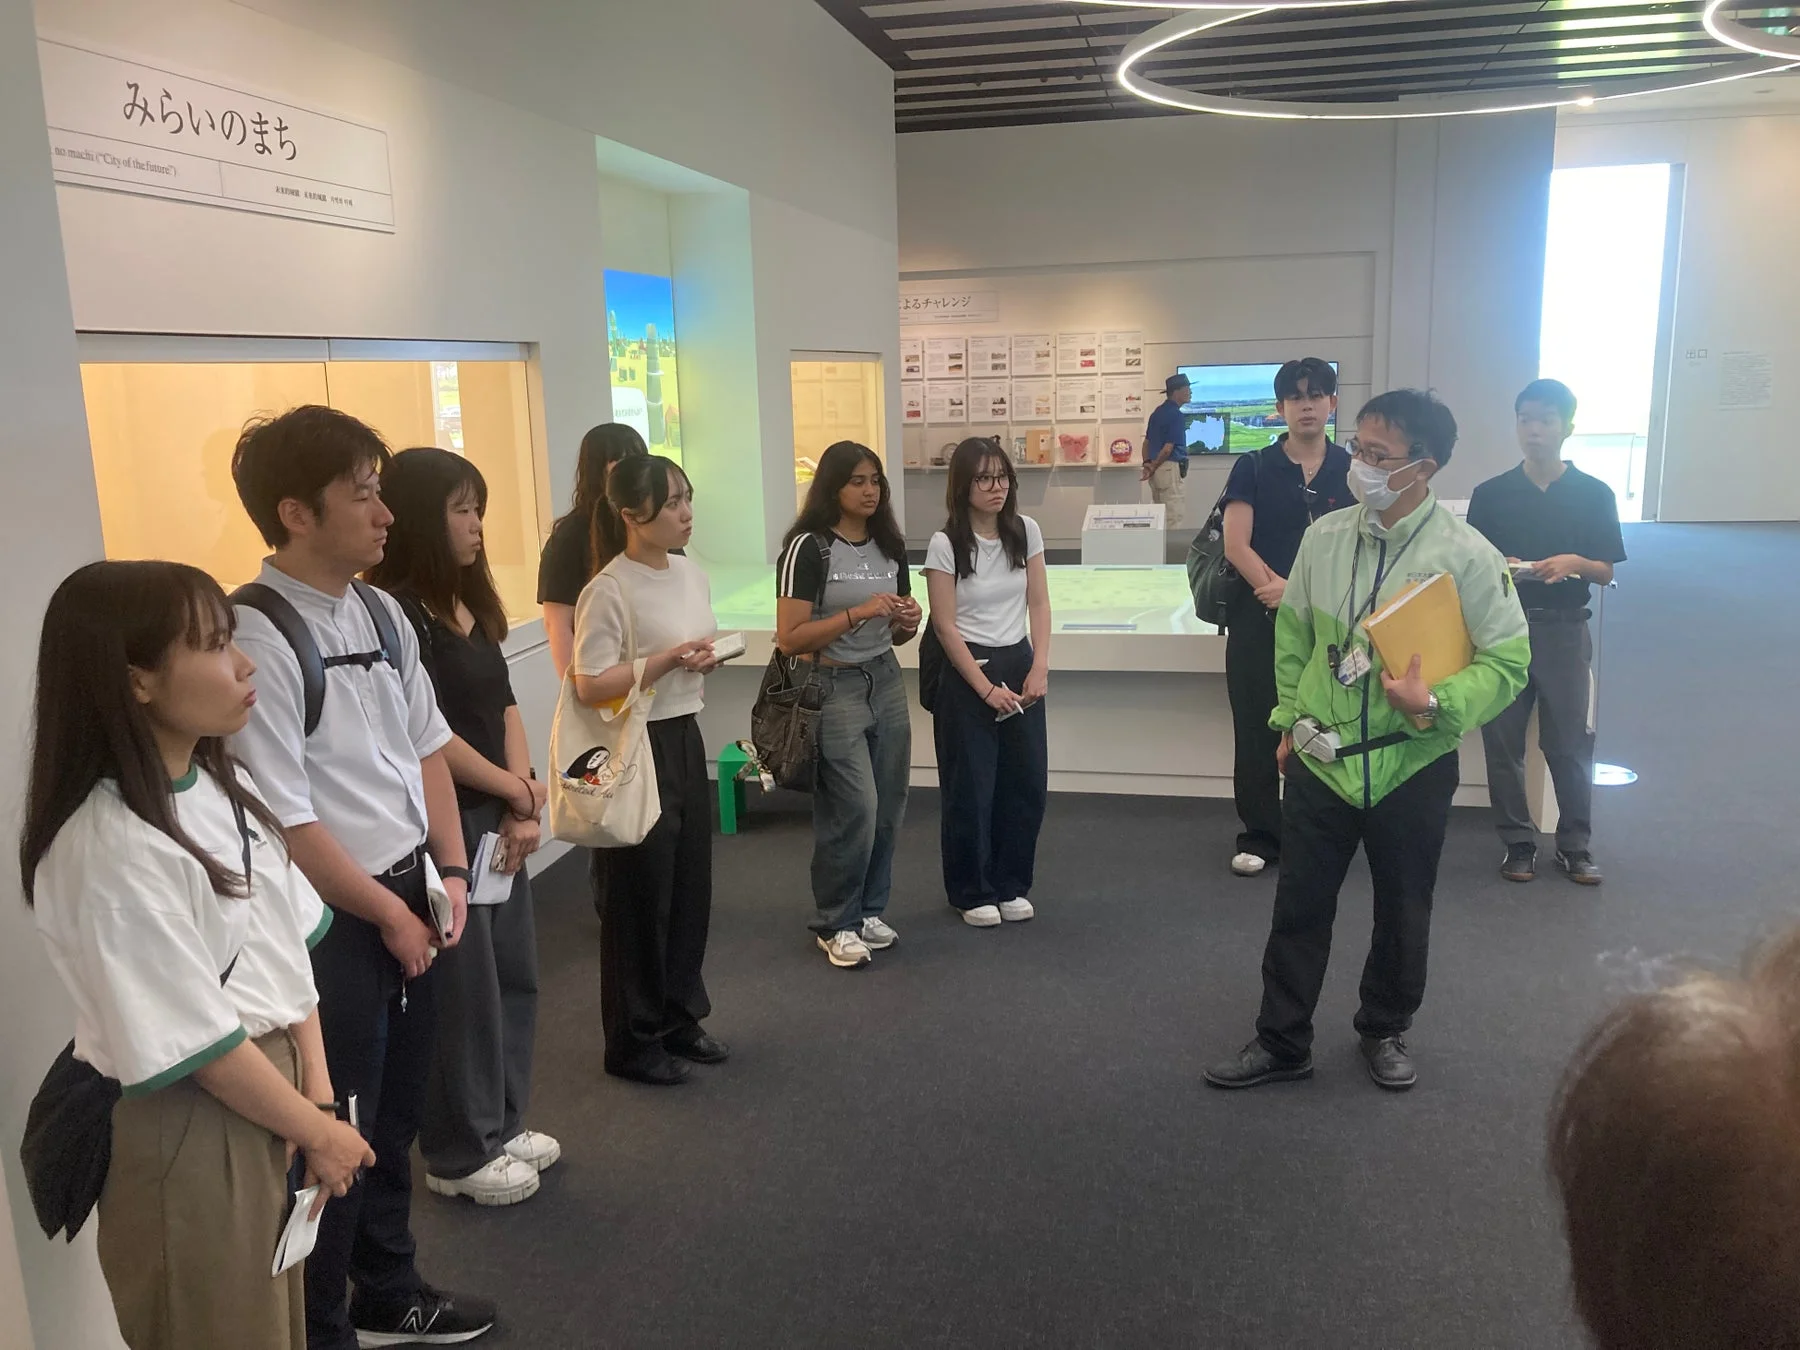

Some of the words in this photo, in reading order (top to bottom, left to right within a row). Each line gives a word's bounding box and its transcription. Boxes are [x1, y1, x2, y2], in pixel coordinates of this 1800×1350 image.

[123, 81, 297, 161] みらいのまち
[67, 149, 94, 161] machi
[122, 157, 131, 167] of
[132, 159, 145, 170] the
[1685, 348, 1708, 359] 出口
